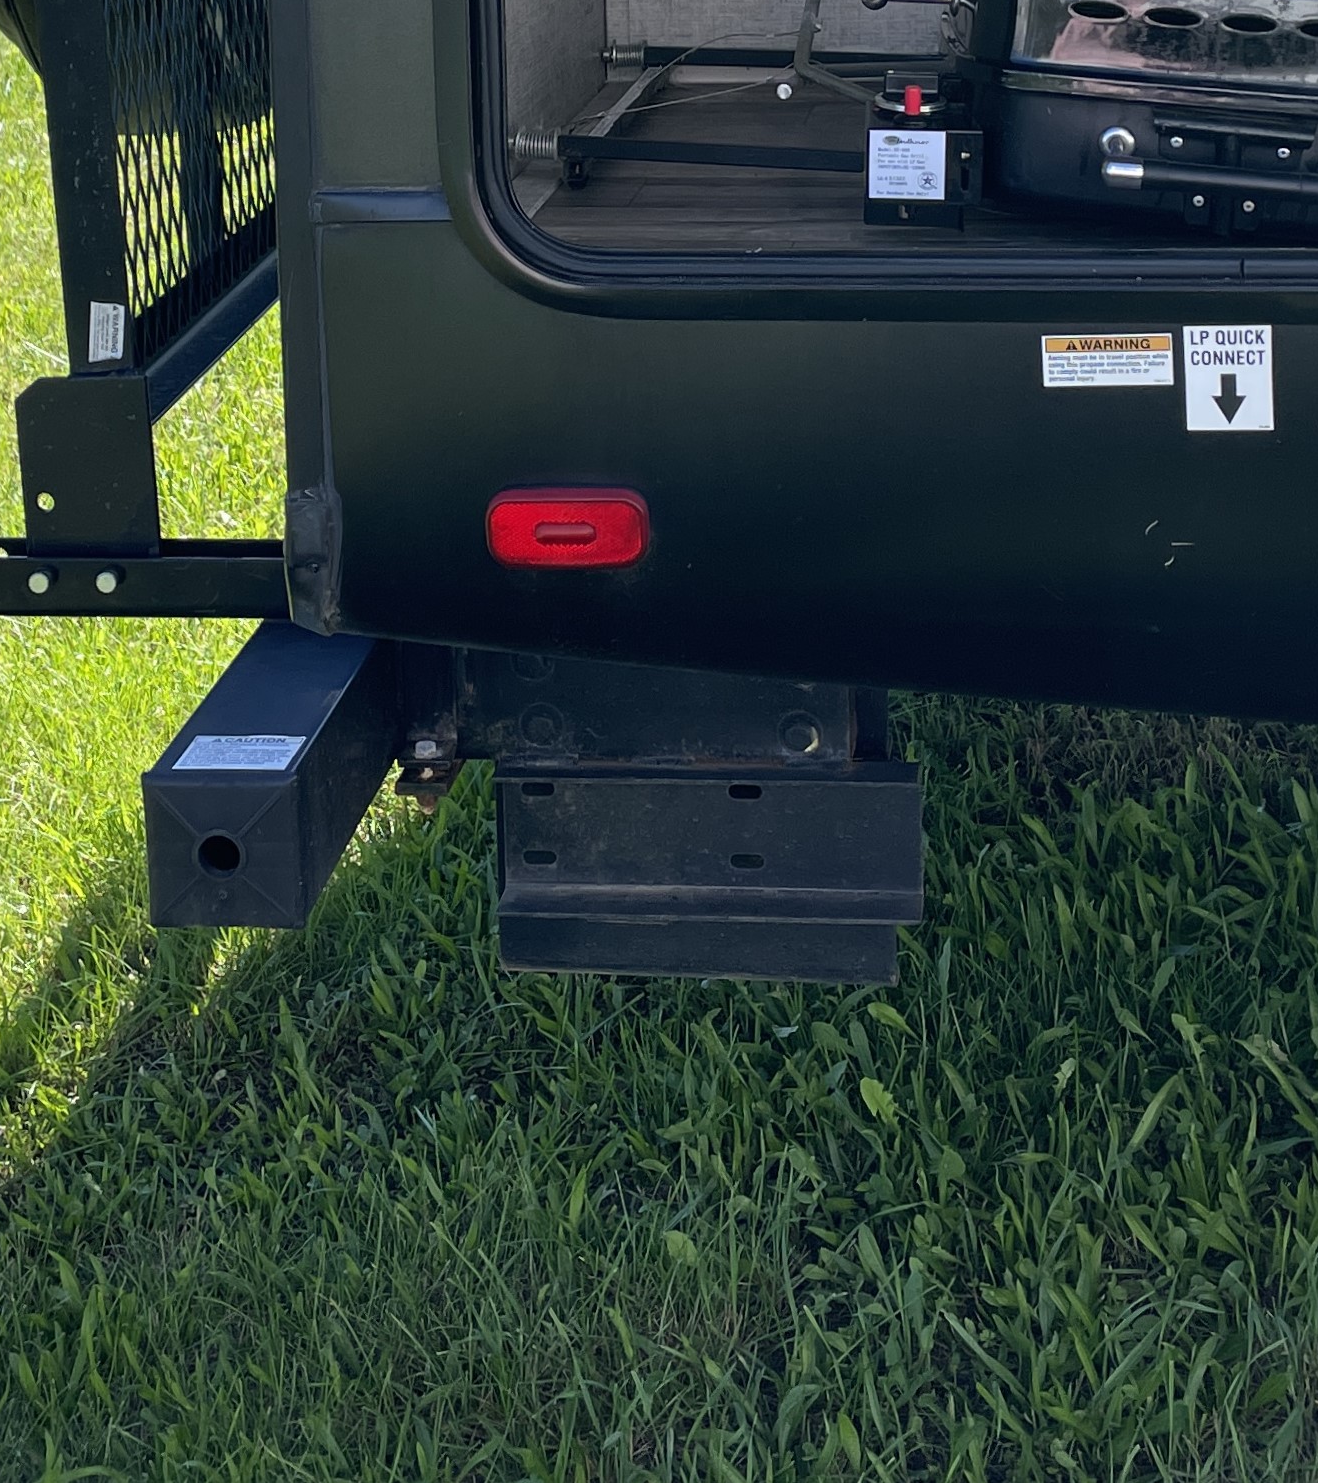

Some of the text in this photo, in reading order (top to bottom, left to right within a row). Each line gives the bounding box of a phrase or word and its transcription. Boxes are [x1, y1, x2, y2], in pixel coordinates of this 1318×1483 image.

[1079, 338, 1151, 350] WARNING
[1190, 329, 1266, 346] LP QUICK
[1190, 350, 1266, 366] CONNECT
